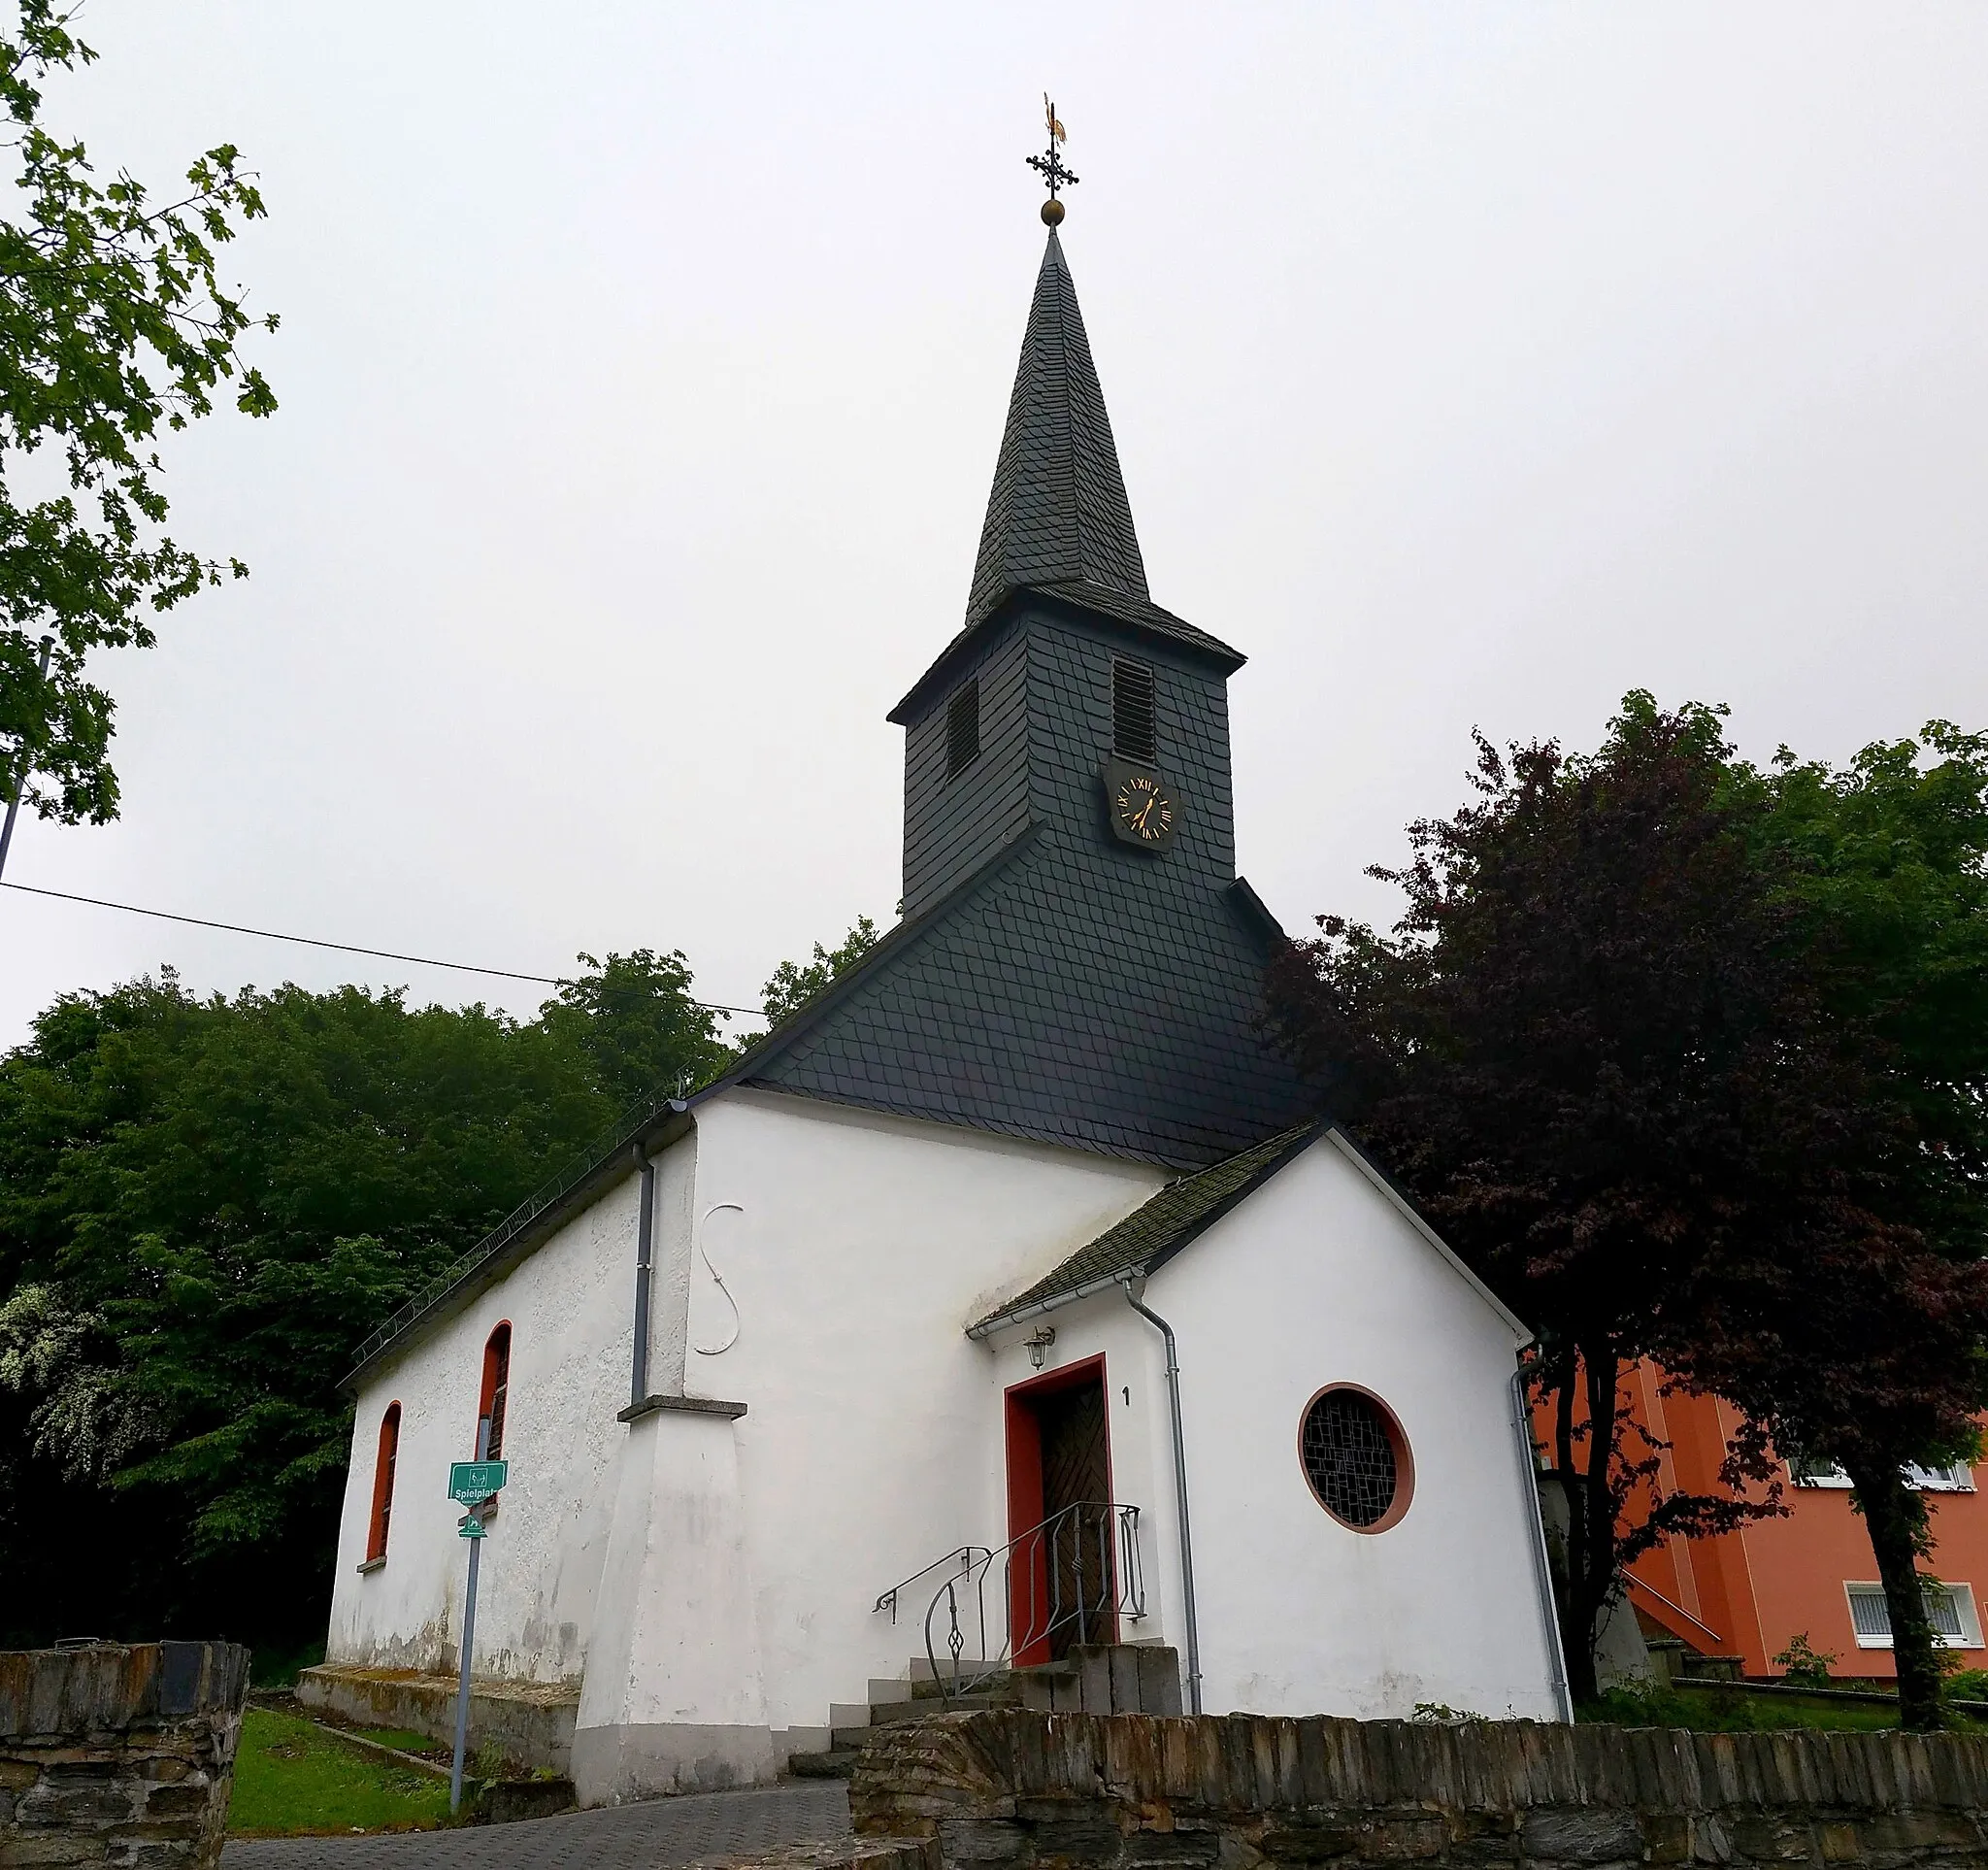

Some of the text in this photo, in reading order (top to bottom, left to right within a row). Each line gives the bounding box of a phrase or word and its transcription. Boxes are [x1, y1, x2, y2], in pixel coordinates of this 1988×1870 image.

[1137, 778, 1152, 791] XII
[1117, 794, 1128, 807] IX
[1161, 810, 1172, 822] III
[1122, 1386, 1130, 1406] 1
[455, 1488, 497, 1500] Spielplat
